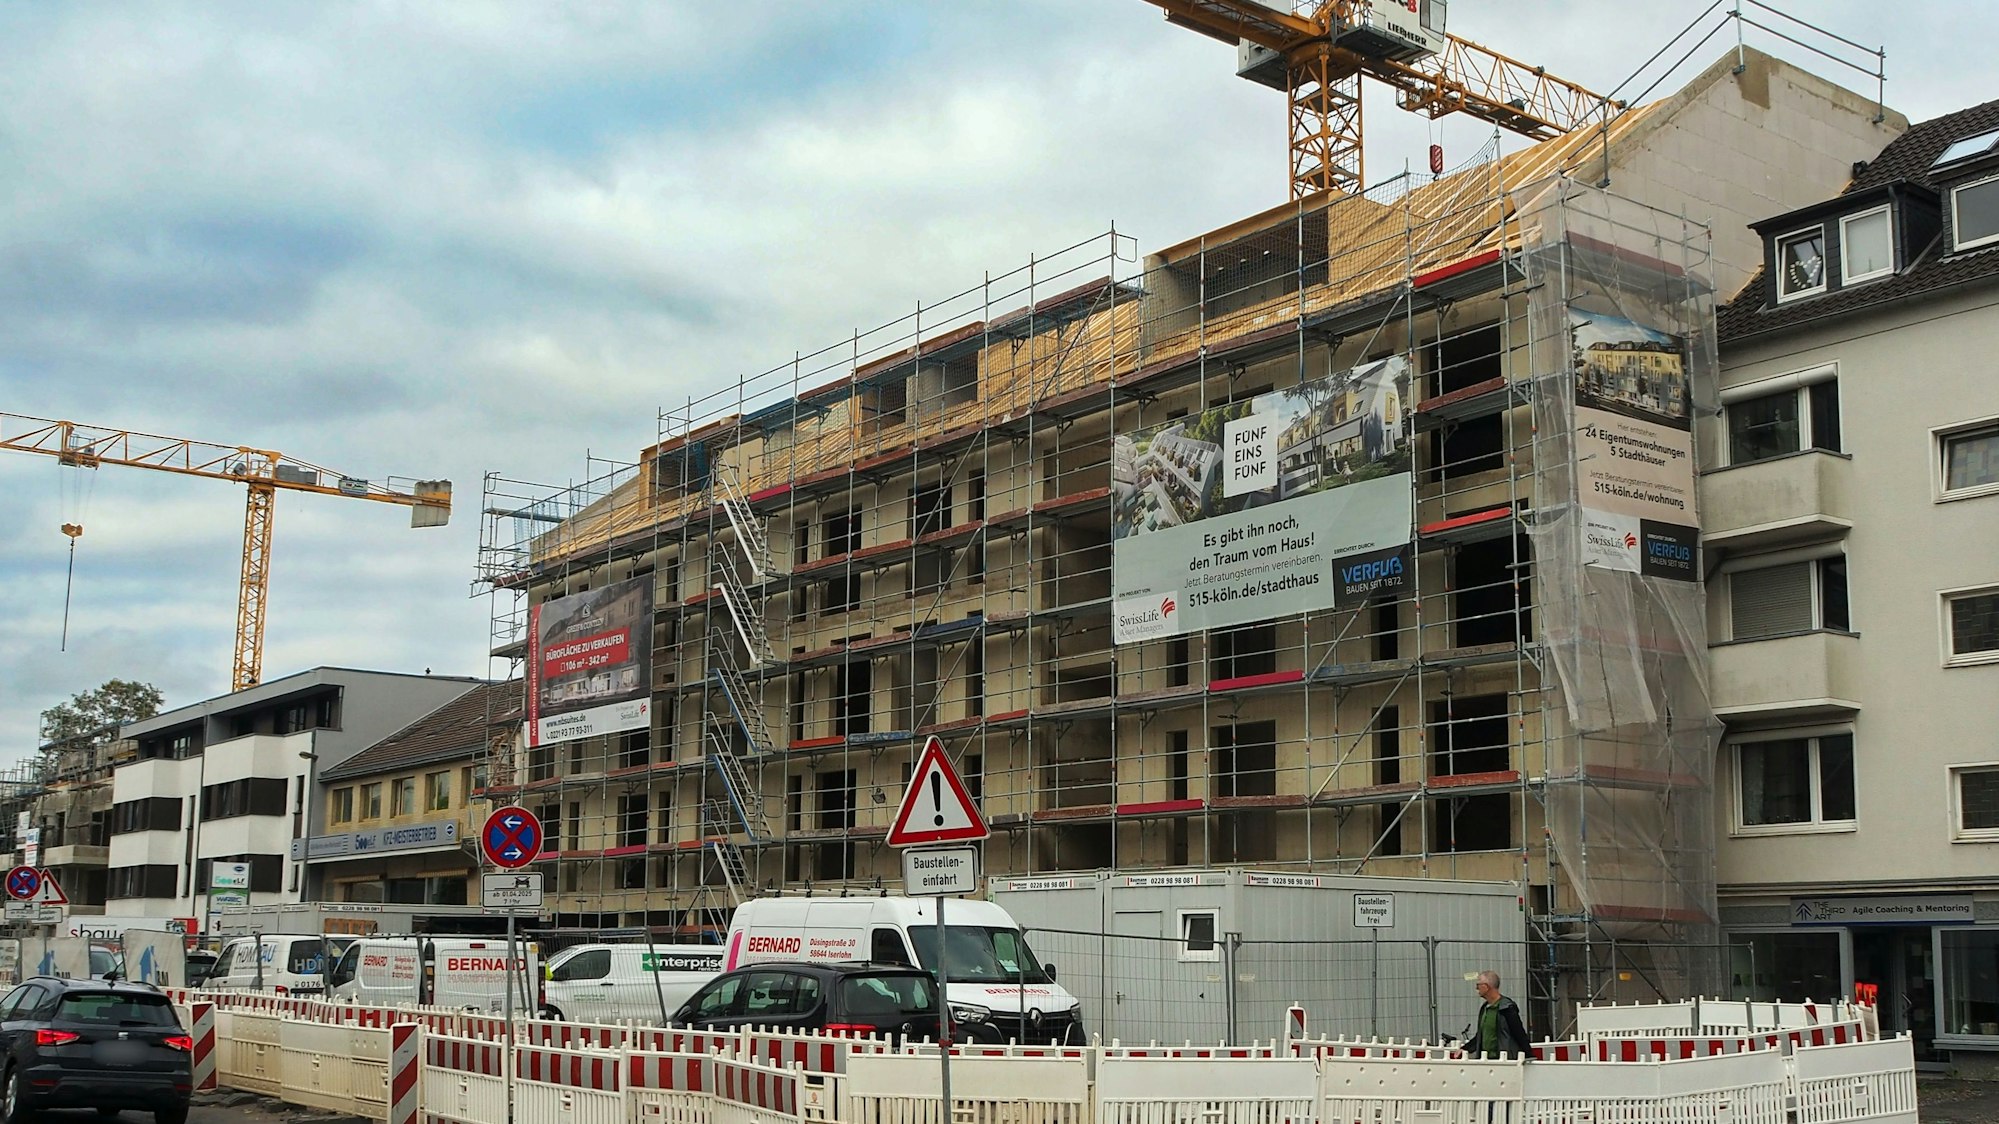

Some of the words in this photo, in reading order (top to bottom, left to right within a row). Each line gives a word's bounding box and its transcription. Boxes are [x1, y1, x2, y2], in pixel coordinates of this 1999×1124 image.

[1388, 22, 1427, 46] LIEBHERR
[1236, 426, 1267, 446] FÜNF
[1586, 428, 1596, 438] 24
[1600, 430, 1686, 459] Eigentumswohnungen
[1235, 445, 1262, 463] EINS
[1610, 446, 1616, 456] 5
[1618, 448, 1666, 466] Stadthäuser
[1235, 461, 1266, 480] FÜNF
[1605, 472, 1652, 488] Beratungstermin
[1594, 482, 1684, 510] 515-köln.de/wohnung
[1204, 534, 1216, 547] Es
[1220, 528, 1244, 548] gibt
[1247, 524, 1264, 538] ihn
[1268, 514, 1299, 533] noch,
[1190, 557, 1209, 571] den
[1213, 550, 1248, 566] Traum
[1252, 544, 1277, 558] vom
[1281, 532, 1315, 552] Haus!
[1342, 557, 1403, 583] VERFUß
[1650, 557, 1667, 565] BAUEN
[1668, 559, 1677, 567] SEIT
[1184, 578, 1201, 588] Jetzt
[1204, 563, 1270, 584] Beratungstermin
[1272, 553, 1323, 570] vereinbaren.
[1189, 573, 1319, 607] 515-köln.de/stadthaus
[1346, 583, 1368, 594] BAUEN
[1370, 580, 1382, 589] SEIT
[1120, 609, 1159, 626] SwissLife
[1136, 624, 1164, 634] Managers
[546, 644, 582, 661] BÜROFLÄCHE
[582, 641, 590, 652] ZU
[590, 634, 624, 650] VERKAUFEN
[566, 661, 576, 670] 106
[576, 658, 584, 668] m²
[589, 655, 599, 666] 342
[601, 652, 608, 662] m²
[546, 713, 586, 728] www.mbsuites.de
[576, 725, 592, 735] 93-311
[384, 826, 436, 846] KFZ-MEISTERBETRIEB
[914, 856, 964, 869] Baustellen-
[922, 874, 957, 886] einfahrt
[1360, 907, 1387, 916] fahrzeuge
[1853, 906, 1873, 915] Agile
[1876, 906, 1914, 914] Coaching
[1926, 904, 1969, 913] Mentoring
[1367, 916, 1379, 924] frei
[71, 924, 124, 939] sbau
[748, 937, 800, 953] BERNARD
[810, 938, 846, 948] Düsingstraße
[364, 955, 387, 966] BERNARD
[828, 950, 852, 958] Iserlohn
[644, 956, 723, 970] enterprise
